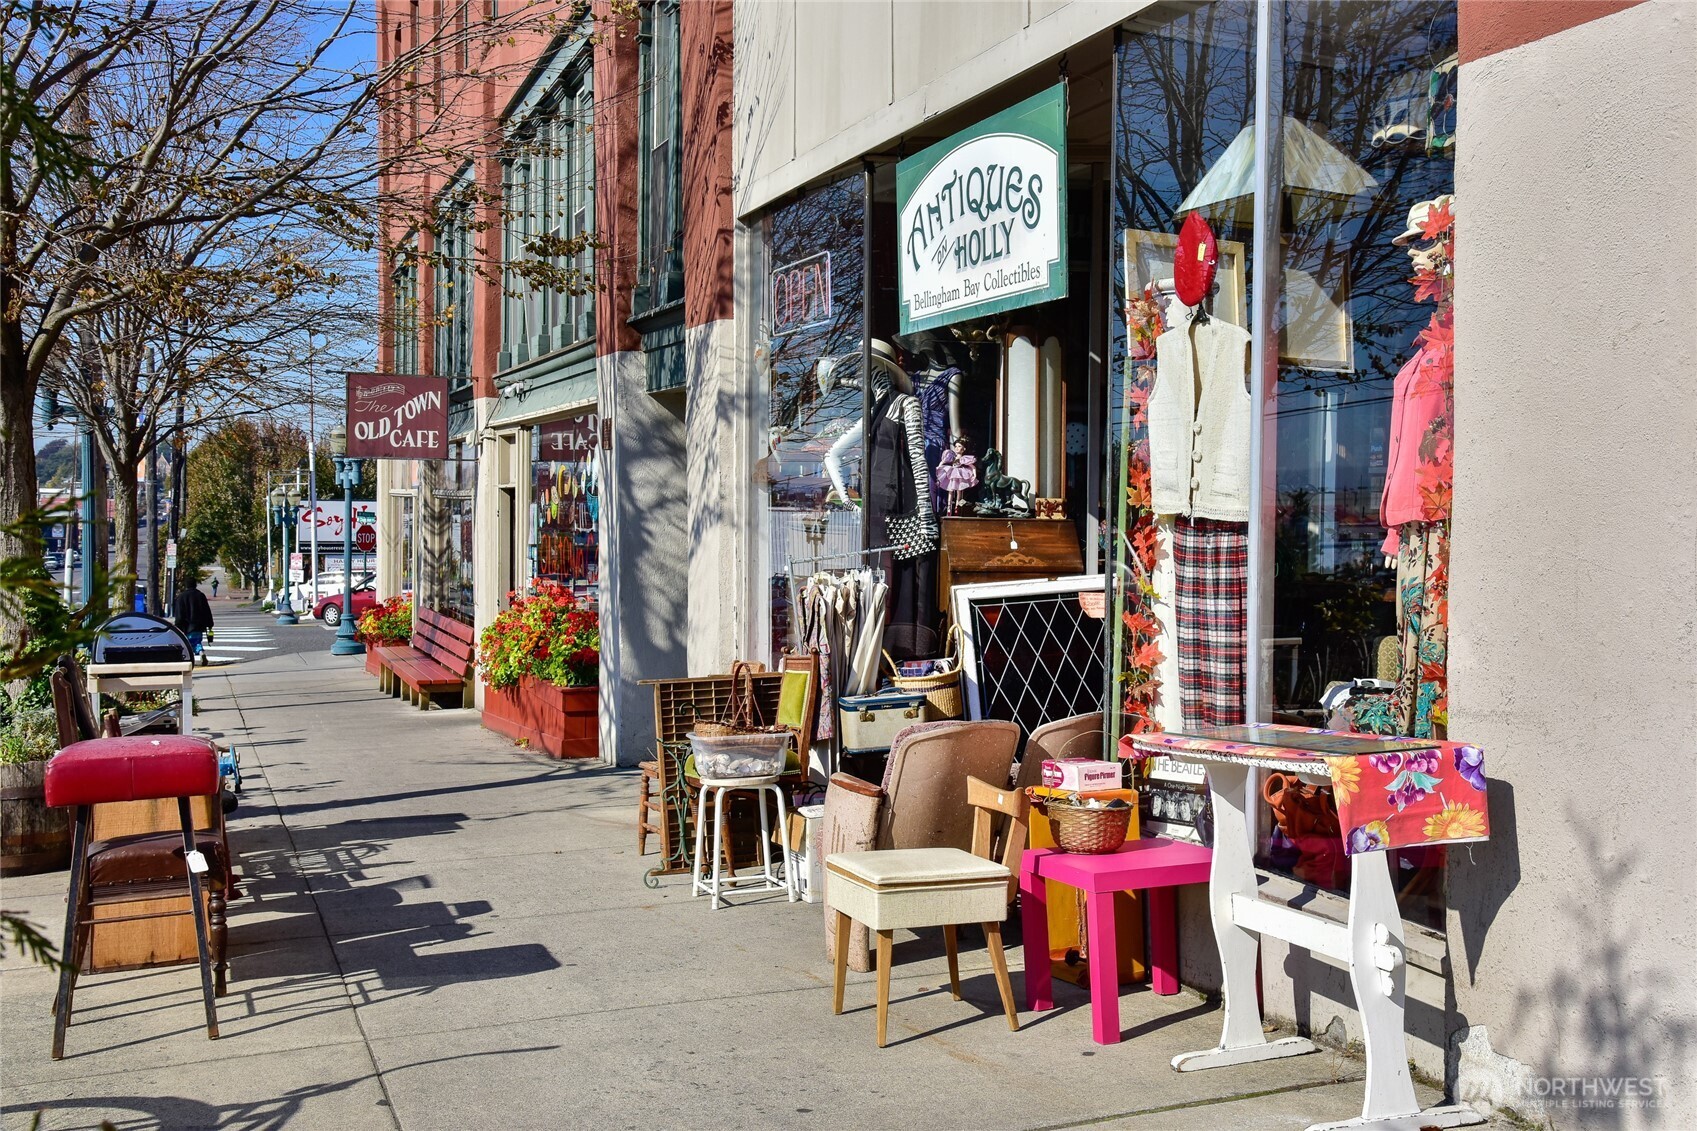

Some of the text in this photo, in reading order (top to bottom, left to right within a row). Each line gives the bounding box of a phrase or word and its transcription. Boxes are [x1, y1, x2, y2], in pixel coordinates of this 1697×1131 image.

[907, 163, 1043, 272] ANTIQUES
[955, 217, 1016, 270] HOLLY
[775, 259, 829, 328] OPEN
[913, 286, 961, 311] Bellingham
[963, 278, 980, 299] Bay
[983, 264, 1041, 292] Collectibles
[354, 399, 394, 413] The
[354, 391, 442, 440] OLD TOWN
[389, 428, 440, 449] CAFE
[357, 533, 376, 544] STOP
[1171, 760, 1206, 776] BEATLE
